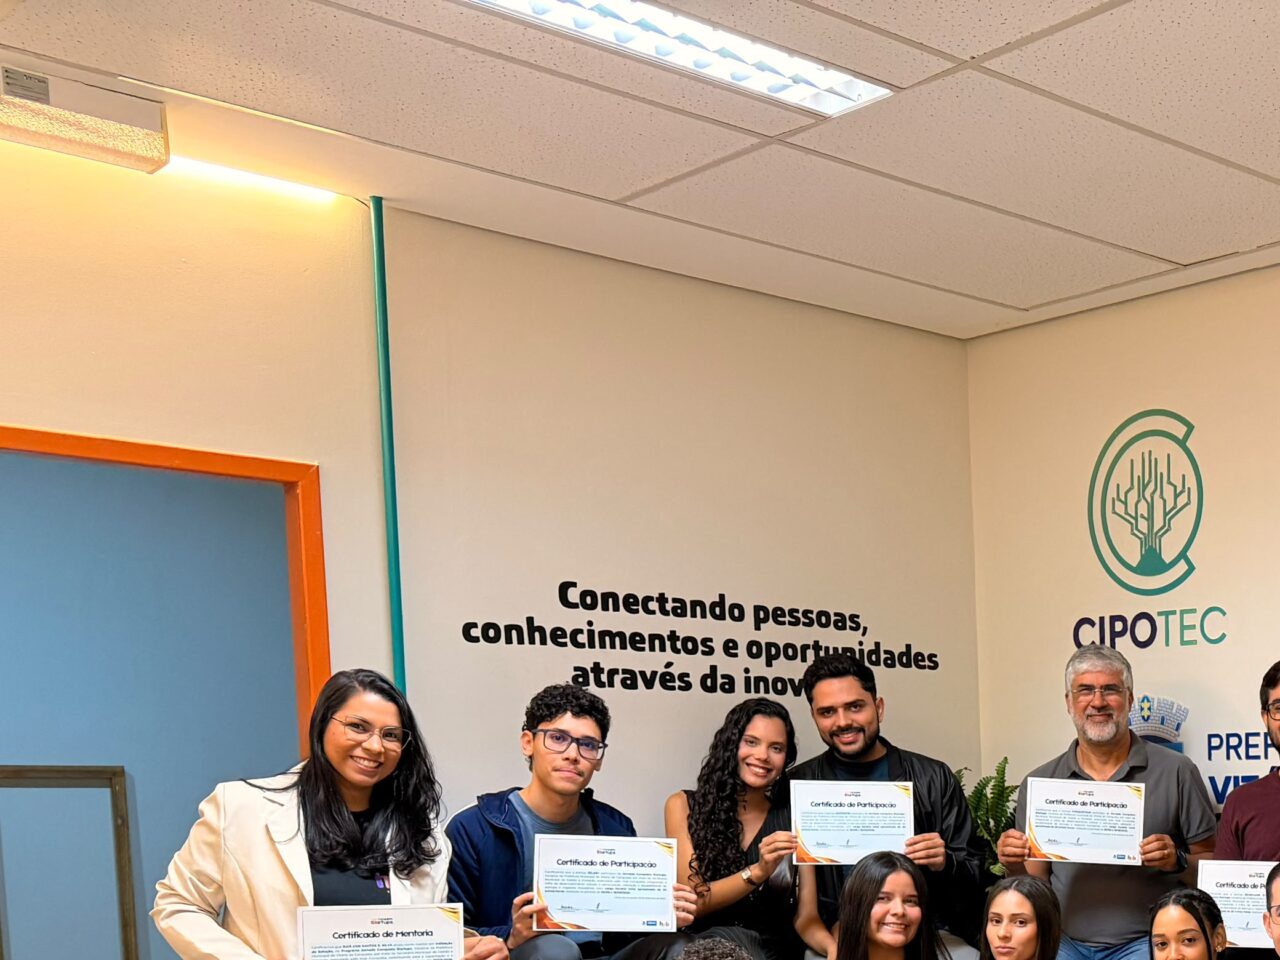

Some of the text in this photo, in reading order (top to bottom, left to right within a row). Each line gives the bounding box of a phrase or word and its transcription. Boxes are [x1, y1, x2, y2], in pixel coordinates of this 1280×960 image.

[557, 580, 868, 637] Conectando pessoas,
[460, 615, 716, 658] conhecimentos
[722, 638, 740, 659] e
[1072, 605, 1228, 650] CIPOTEC
[571, 661, 693, 692] através
[699, 664, 736, 694] da
[1044, 798, 1080, 806] Certificado
[556, 858, 598, 867] Certificado
[598, 859, 610, 867] de
[1215, 881, 1250, 889] Certificado
[332, 929, 434, 940] Certificado de Mentoria
